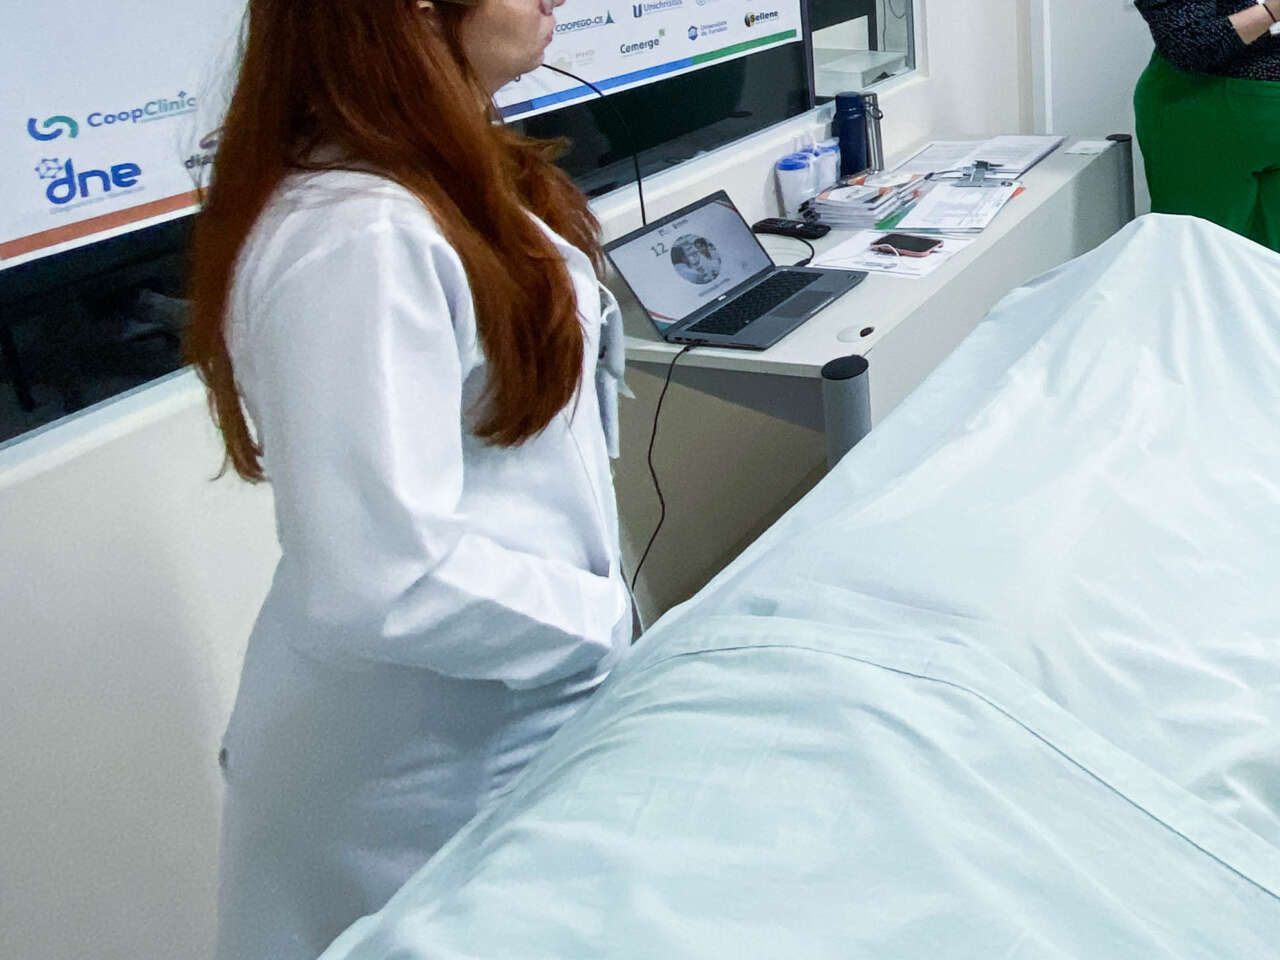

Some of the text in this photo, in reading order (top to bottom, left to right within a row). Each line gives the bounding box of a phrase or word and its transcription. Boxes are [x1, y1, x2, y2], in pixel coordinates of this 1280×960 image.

[620, 38, 660, 54] Cemerge
[87, 91, 197, 128] CoopClinic
[46, 157, 142, 205] dne
[650, 242, 668, 257] 12
